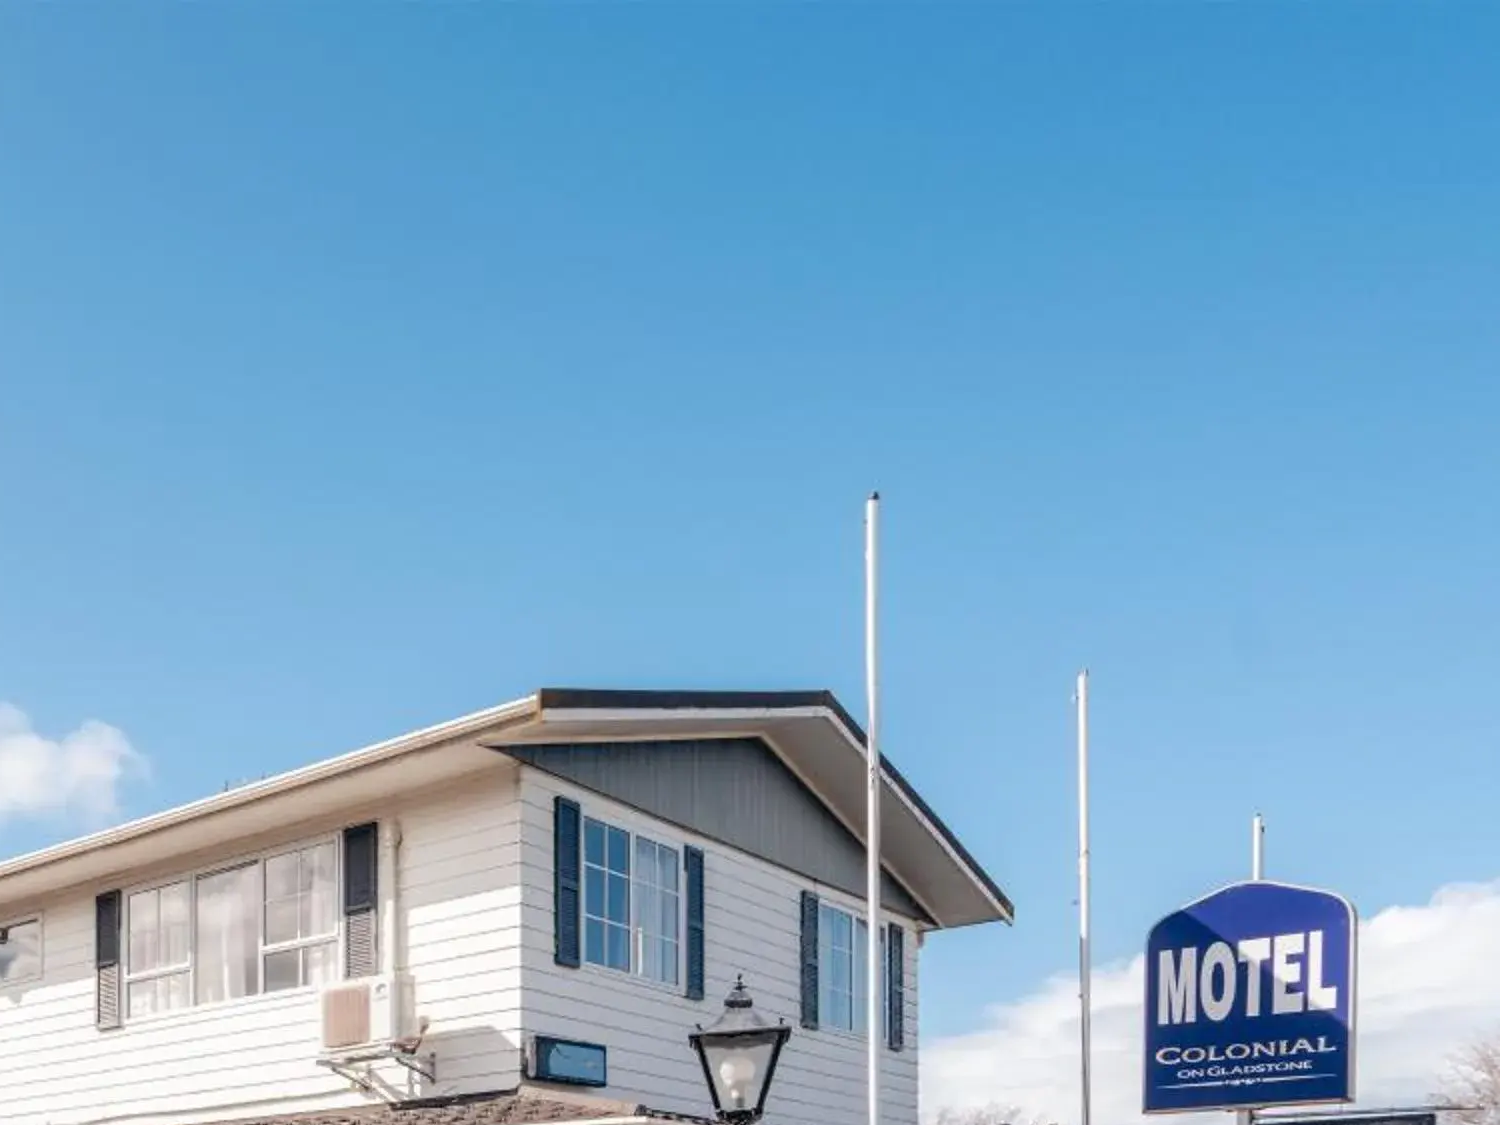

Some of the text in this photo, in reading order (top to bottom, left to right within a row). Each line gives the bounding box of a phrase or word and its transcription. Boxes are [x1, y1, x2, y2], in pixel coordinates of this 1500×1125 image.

[1158, 930, 1337, 1024] MOTEL
[1156, 1036, 1336, 1064] COLONIAL
[1177, 1060, 1312, 1079] ON GLADSTONE
